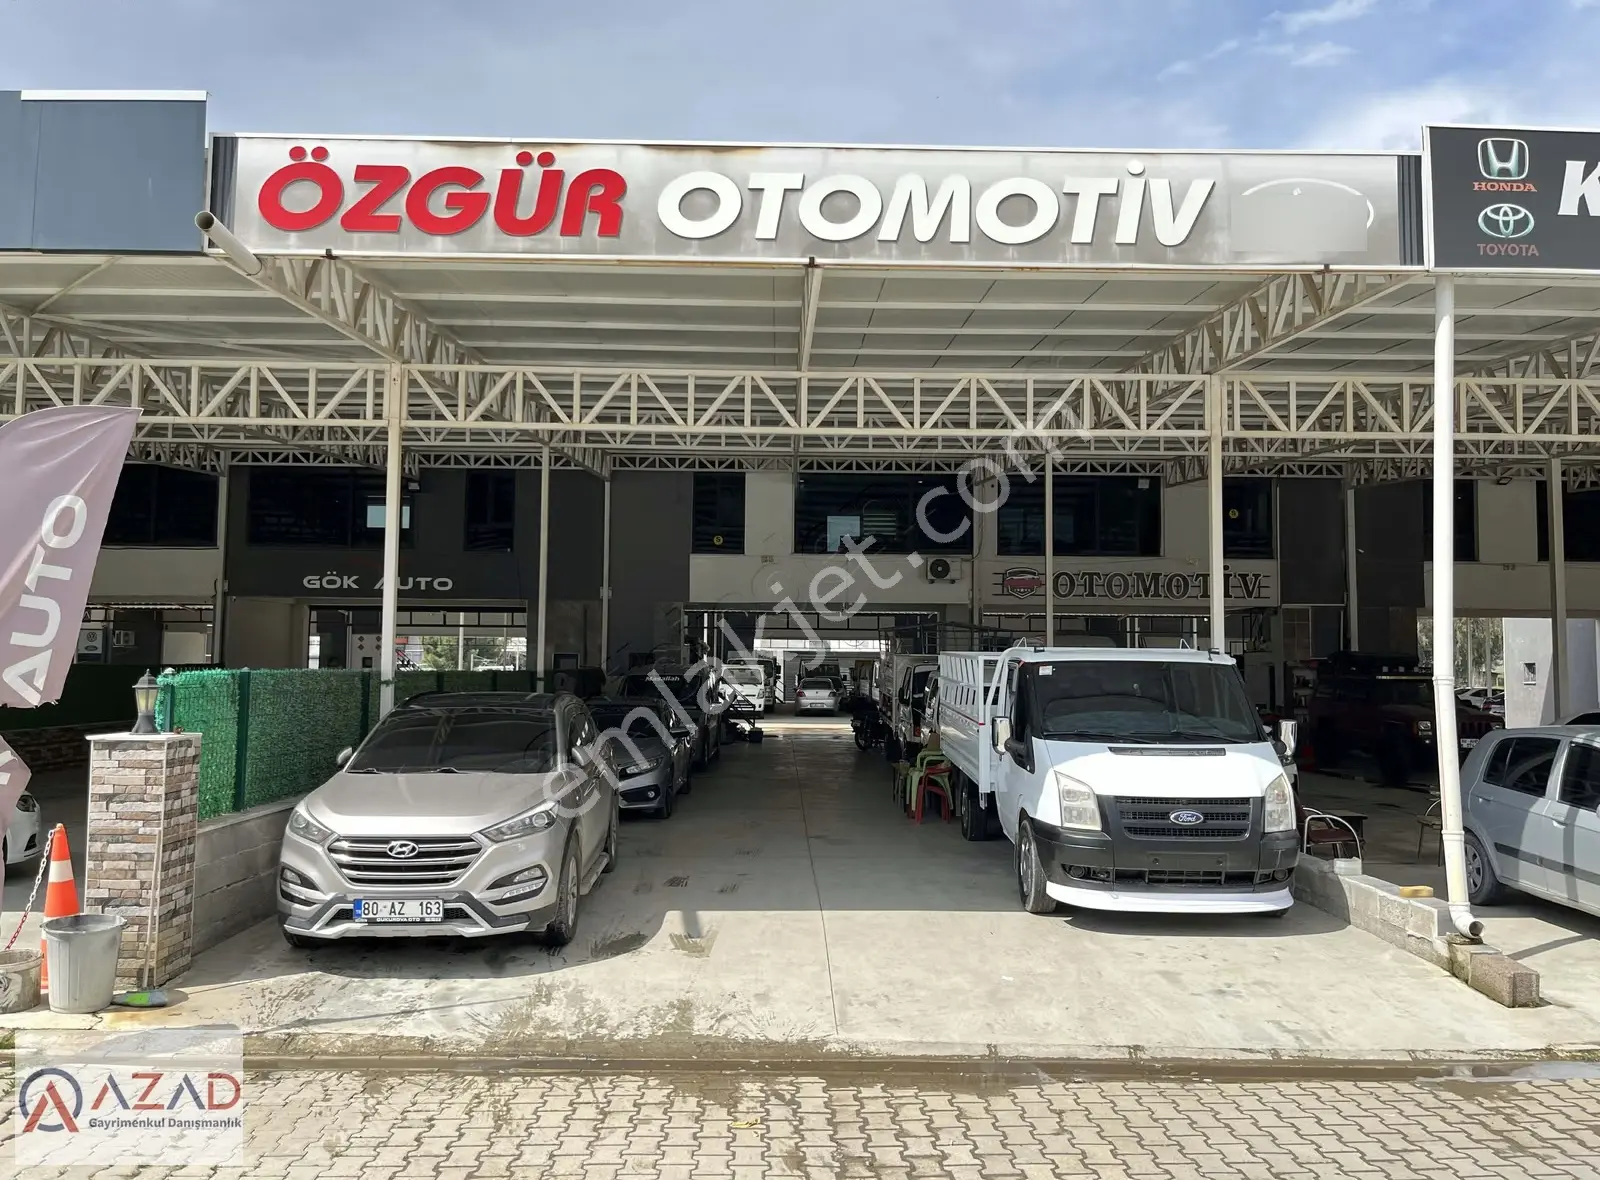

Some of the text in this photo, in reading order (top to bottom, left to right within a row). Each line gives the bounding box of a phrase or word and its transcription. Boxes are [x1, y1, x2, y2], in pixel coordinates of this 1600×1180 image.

[1472, 181, 1538, 193] HONDA
[258, 145, 1215, 247] ÖZGÜR OTOMOTİV
[1476, 243, 1539, 257] TOYOTA
[302, 571, 360, 589] GÖK
[2, 494, 88, 706] AUTO
[362, 901, 379, 916] 80
[389, 901, 406, 916] AZ
[419, 901, 441, 916] 163
